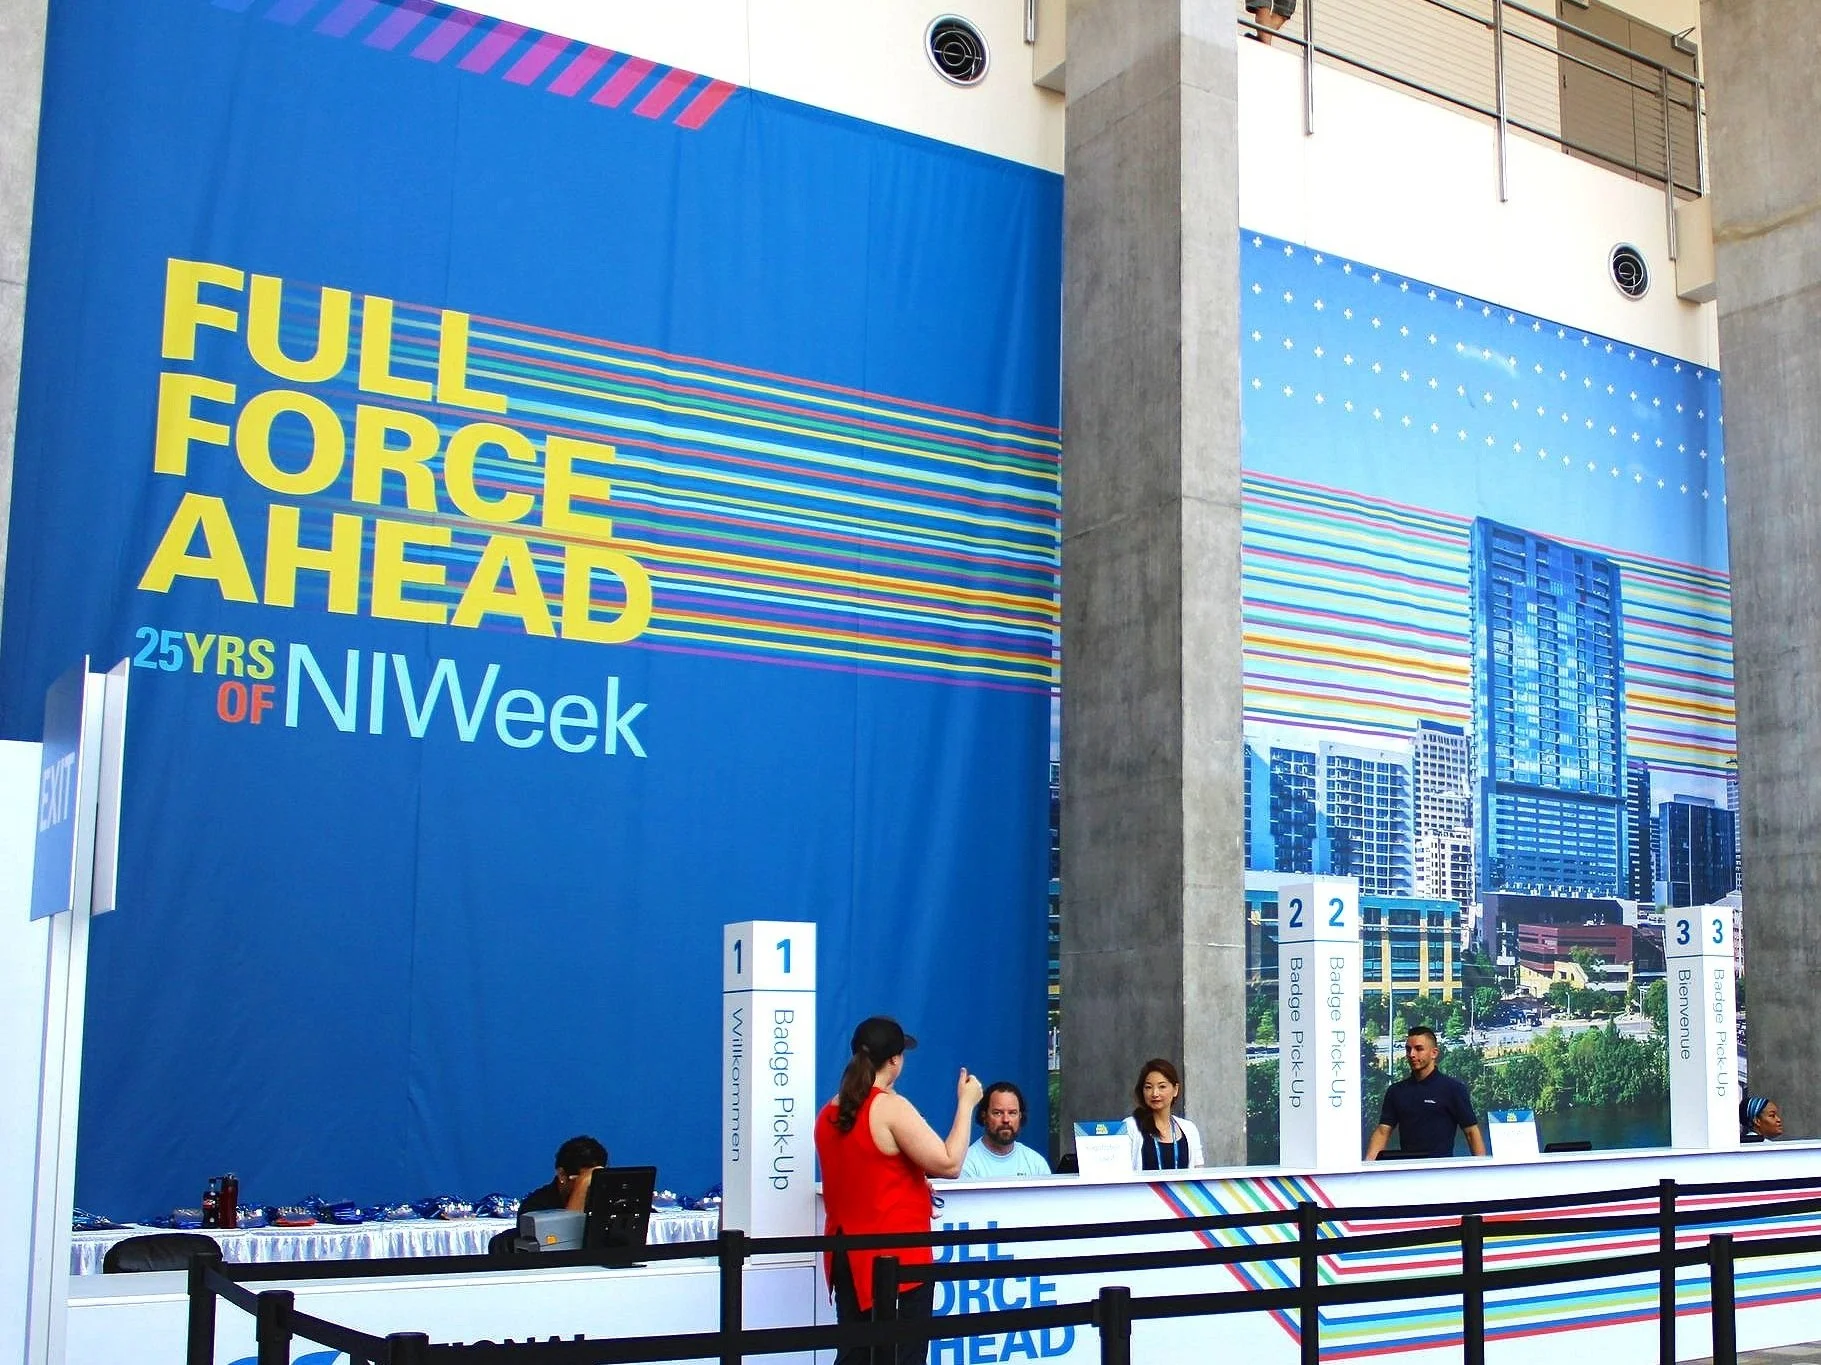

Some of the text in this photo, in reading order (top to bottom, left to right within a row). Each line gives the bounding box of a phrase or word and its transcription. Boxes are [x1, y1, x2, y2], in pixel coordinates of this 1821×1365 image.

[161, 257, 507, 414] FULL
[154, 372, 616, 537] FORCE
[137, 493, 653, 645] AHEAD
[133, 626, 275, 680] 25YRS
[216, 681, 275, 725] OF
[285, 644, 648, 758] NIWeek
[39, 751, 75, 832] EXIT
[1289, 898, 1303, 928] 2
[1328, 897, 1345, 928] 2
[1676, 919, 1690, 945] 3
[1711, 918, 1723, 944] 3
[733, 939, 743, 974] 1
[776, 938, 791, 973] 1
[1288, 957, 1304, 1109] Badge Pick-Up
[1327, 957, 1346, 1108] Badge Pick-Up
[1678, 969, 1691, 1060] Bienvenue
[1712, 968, 1728, 1097] Badge Pick-Up
[731, 1007, 744, 1162] Willkommen
[769, 1009, 794, 1191] Badge Pick-Up
[932, 1276, 1057, 1316] ORCE
[930, 1326, 1075, 1365] HEAD
